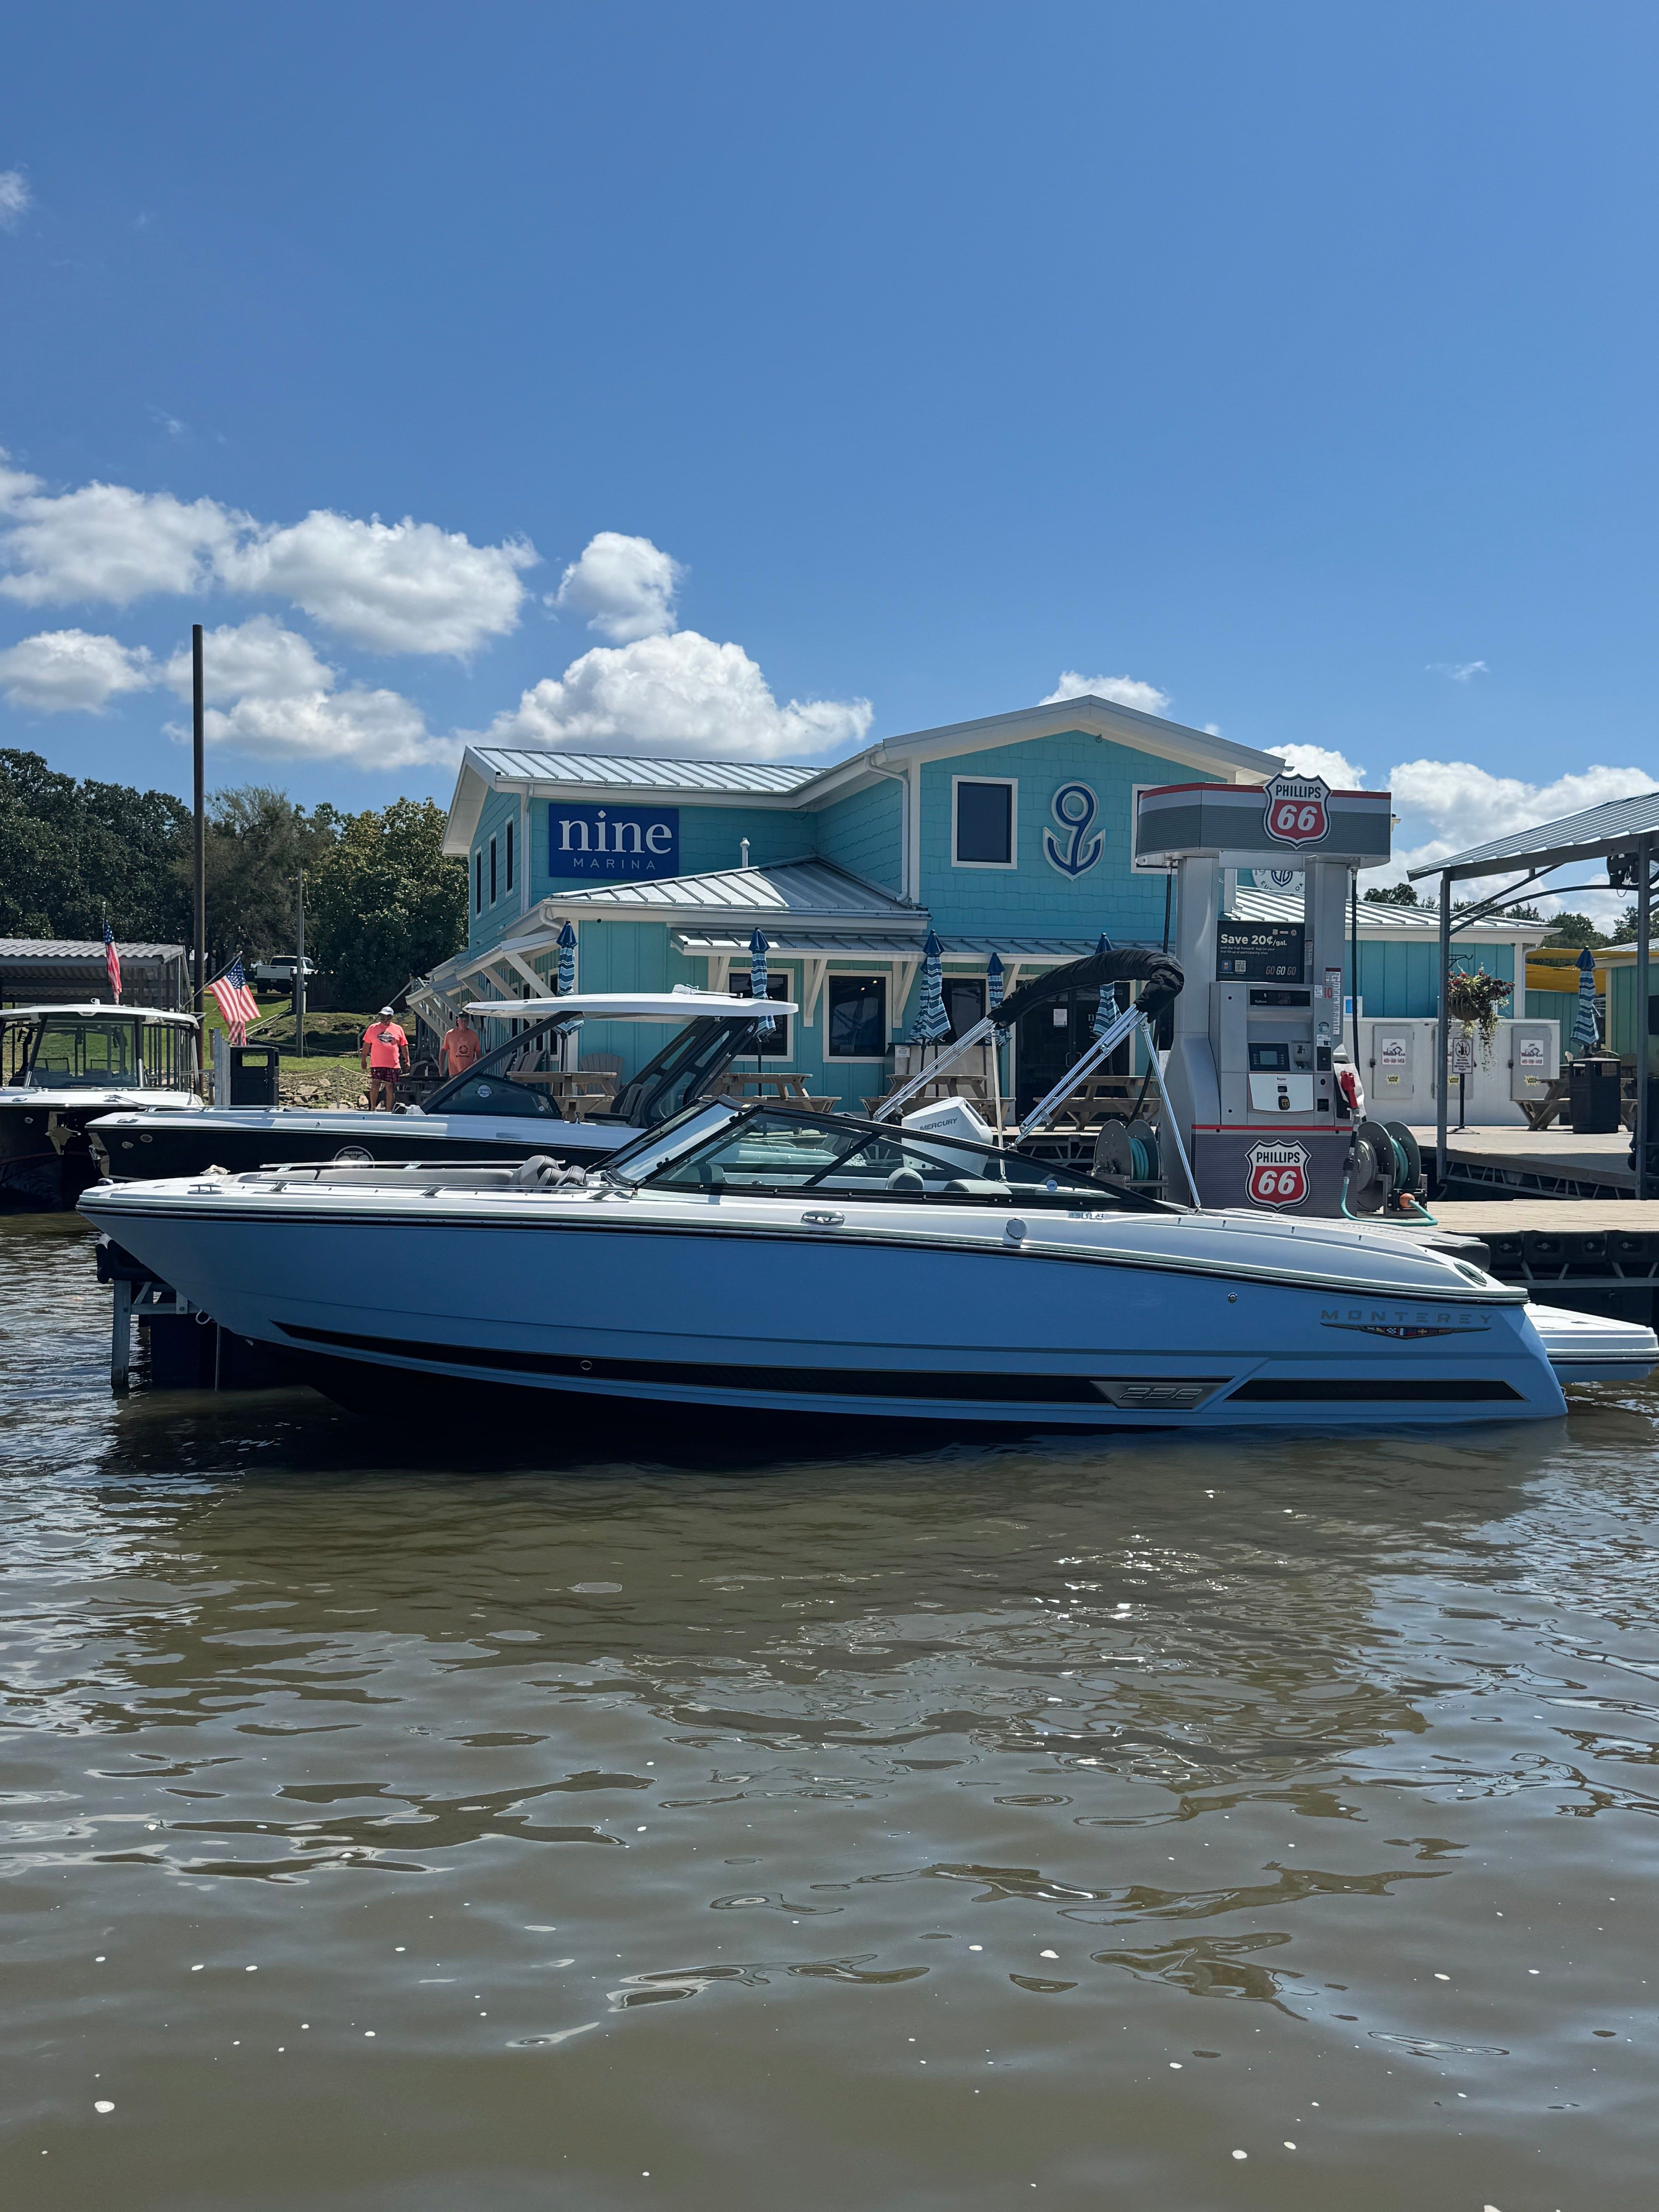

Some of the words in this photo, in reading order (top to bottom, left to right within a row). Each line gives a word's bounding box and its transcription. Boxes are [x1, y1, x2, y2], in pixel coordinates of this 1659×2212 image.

[1276, 785, 1321, 799] PHILLIPS
[1277, 804, 1318, 831] 66
[558, 810, 672, 854] nine
[573, 858, 656, 870] MARINA
[1221, 934, 1249, 944] Save
[1266, 966, 1275, 975] GO
[1276, 966, 1286, 975] GO
[1287, 966, 1297, 975] GO
[920, 1118, 958, 1130] MERCURY
[1257, 1152, 1300, 1163] PHILLIPS
[1259, 1170, 1297, 1195] 66
[1321, 1309, 1492, 1324] MONTEREY
